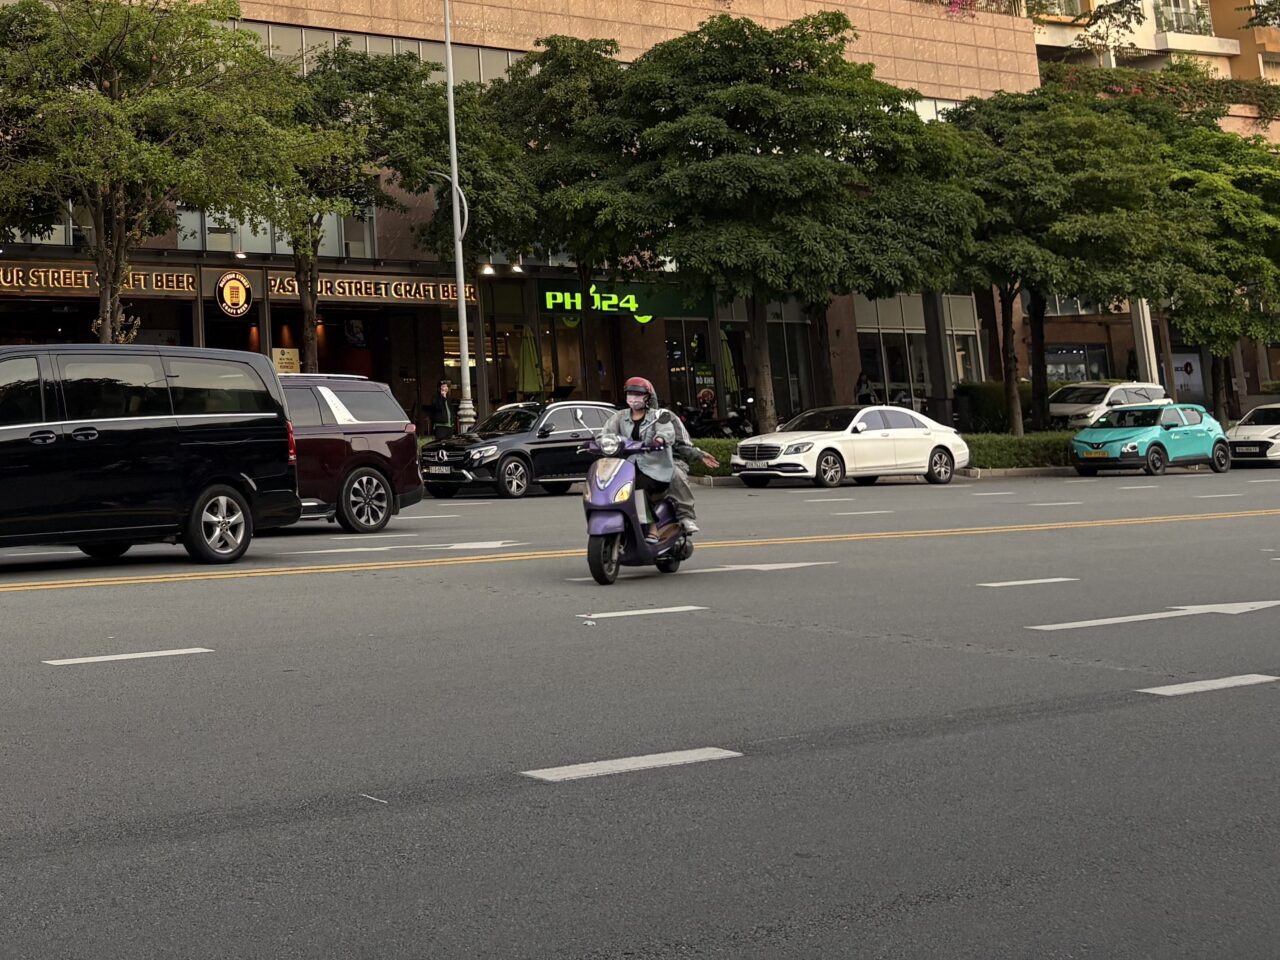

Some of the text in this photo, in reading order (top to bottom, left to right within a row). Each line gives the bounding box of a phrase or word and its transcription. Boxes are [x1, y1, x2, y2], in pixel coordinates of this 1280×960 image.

[28, 268, 94, 289] STREET
[152, 272, 197, 292] BEER
[335, 279, 389, 298] STREET
[391, 281, 437, 300] CRAFT
